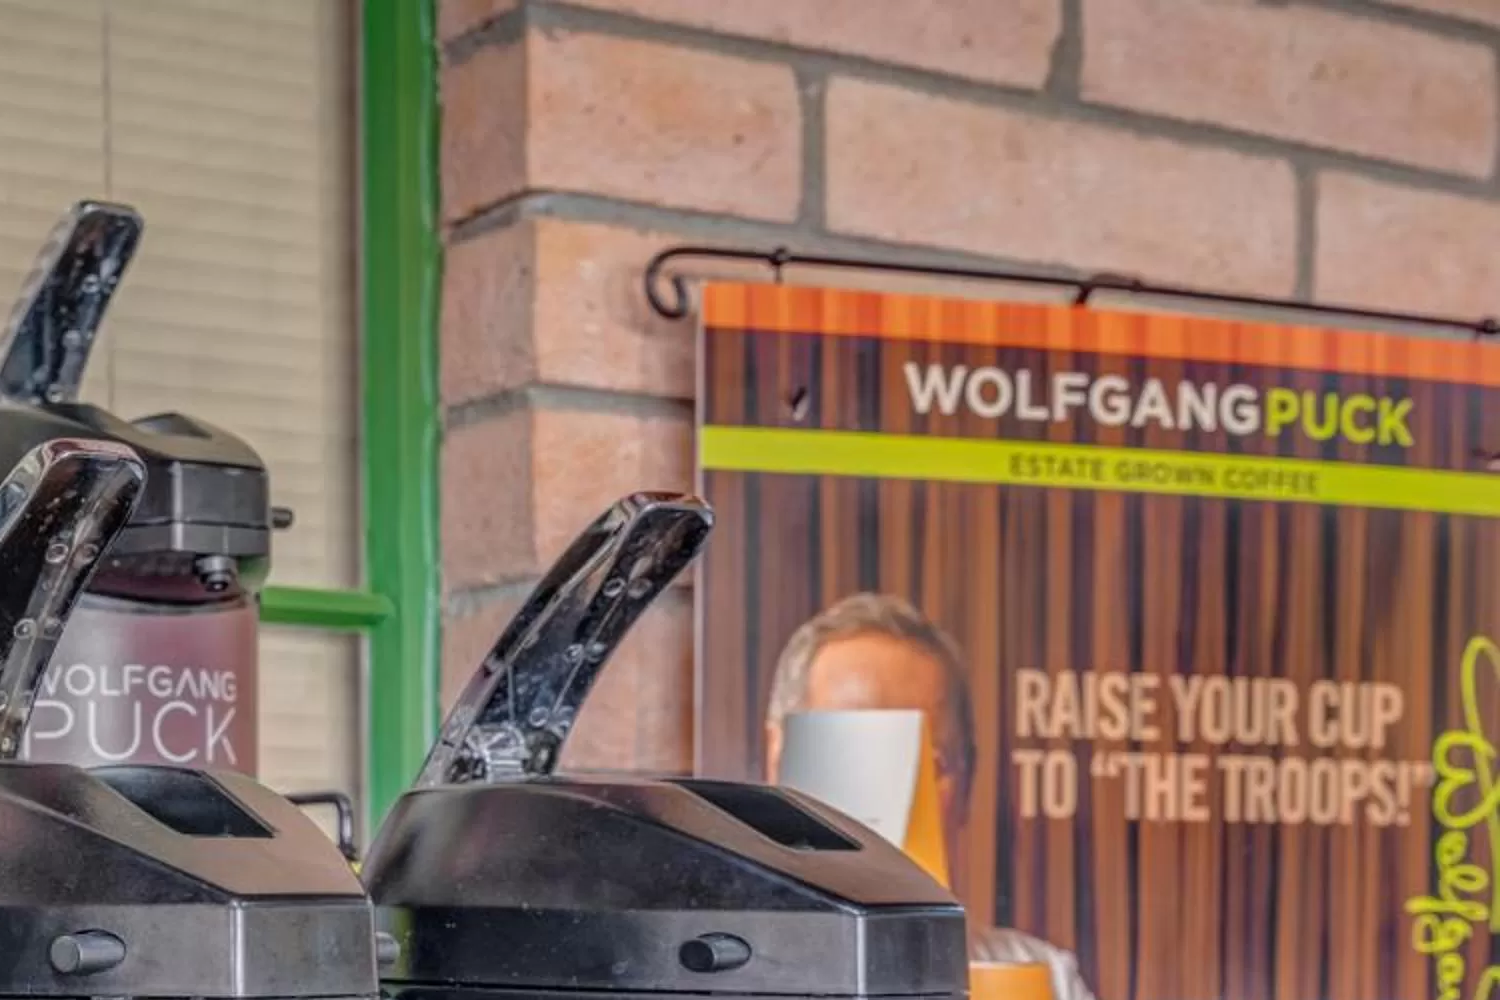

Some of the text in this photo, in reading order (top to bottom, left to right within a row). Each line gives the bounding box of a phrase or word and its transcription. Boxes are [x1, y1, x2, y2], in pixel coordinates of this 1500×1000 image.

[1010, 453, 1319, 496] ESTATE GROWN COFFEE
[22, 701, 239, 766] PUCK
[1015, 668, 1405, 750] RAISE YOUR CUP
[1011, 749, 1078, 819] TO
